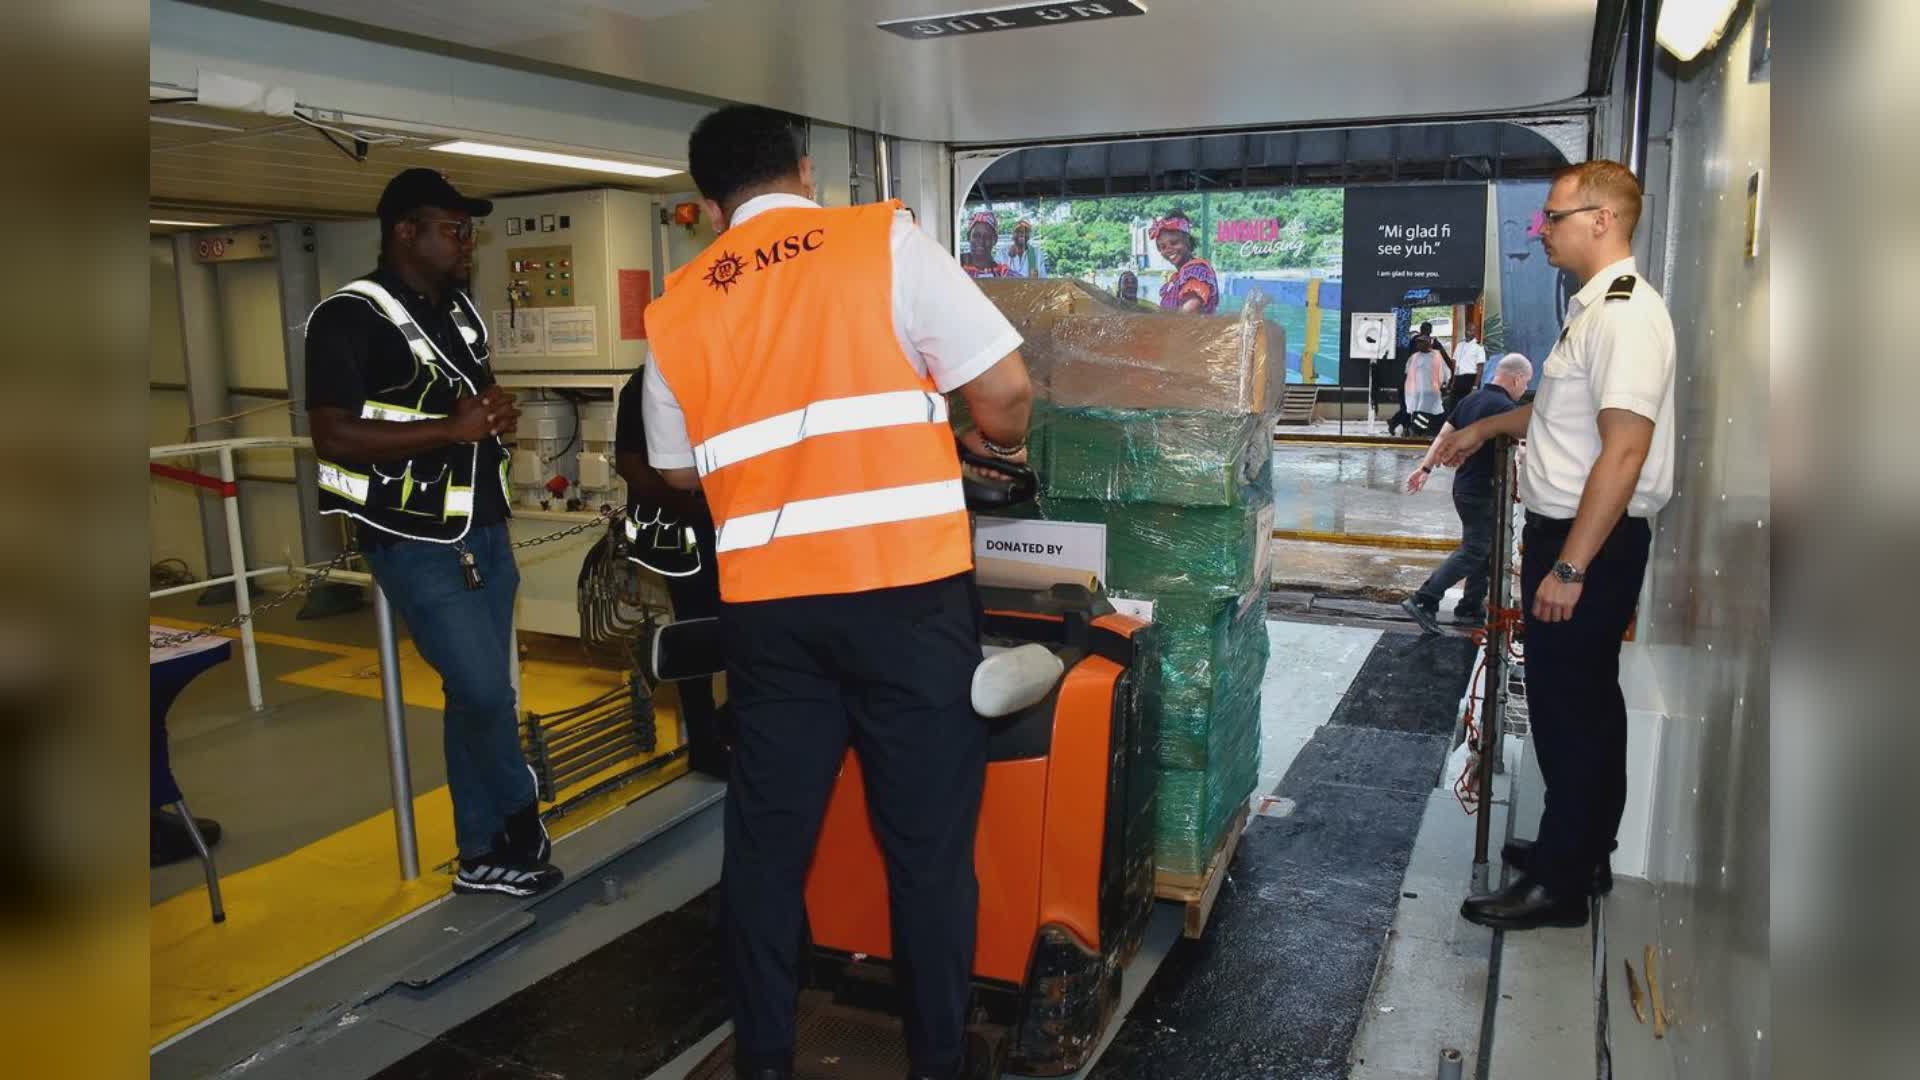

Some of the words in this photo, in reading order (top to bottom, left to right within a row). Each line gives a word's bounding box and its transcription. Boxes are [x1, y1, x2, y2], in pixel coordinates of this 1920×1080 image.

[1405, 223, 1438, 241] glad
[1441, 223, 1451, 238] fi
[755, 228, 825, 272] MSC
[1240, 239, 1305, 258] Cruising
[1377, 244, 1402, 255] see
[1391, 269, 1406, 278] glad
[986, 539, 1045, 554] DONATED
[1046, 544, 1064, 555] BY
